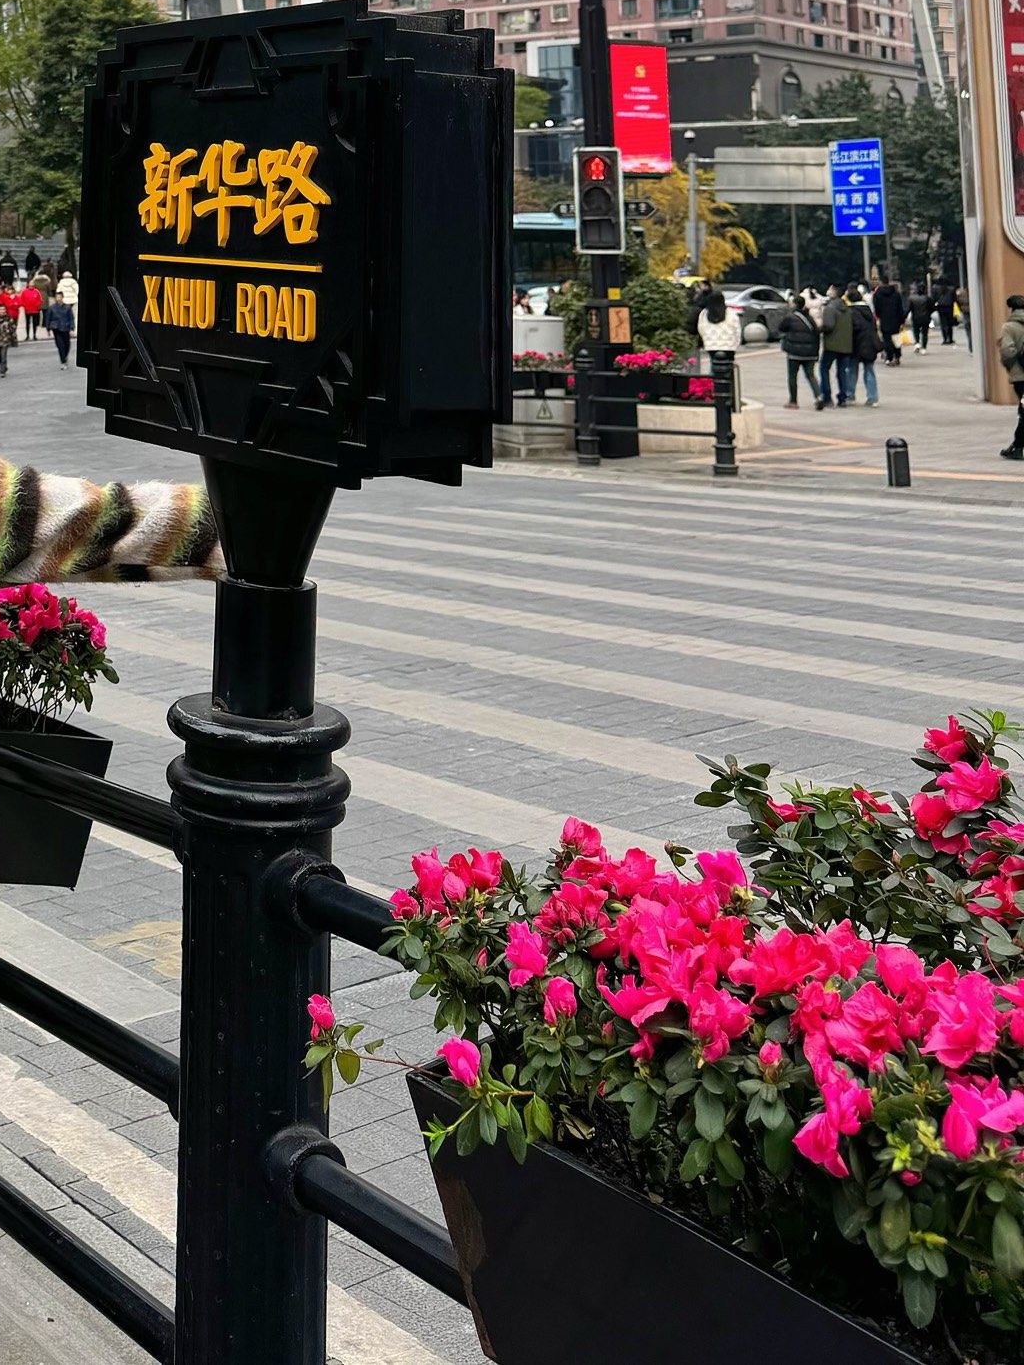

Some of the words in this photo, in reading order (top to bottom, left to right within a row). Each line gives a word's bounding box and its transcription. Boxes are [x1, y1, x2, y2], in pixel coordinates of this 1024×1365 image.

[138, 139, 331, 248] 新华路
[236, 282, 316, 342] ROAD
